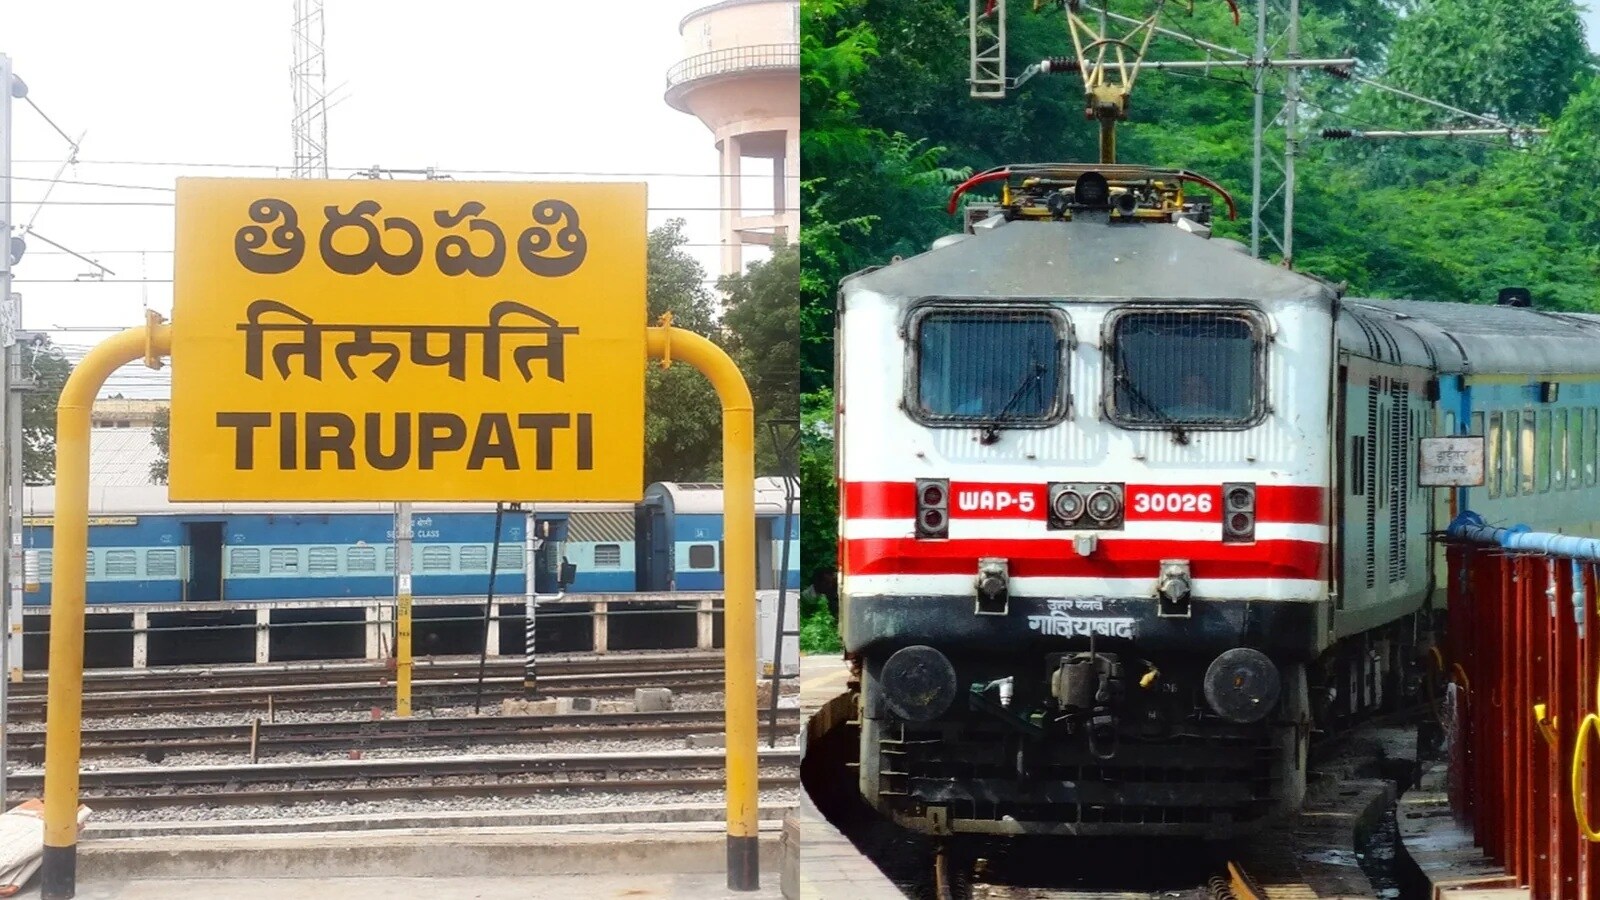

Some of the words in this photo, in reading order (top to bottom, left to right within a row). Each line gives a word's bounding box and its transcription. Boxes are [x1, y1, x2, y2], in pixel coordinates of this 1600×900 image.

[234, 198, 588, 277] తిరుపతి
[236, 299, 580, 383] तिरुपति
[216, 411, 594, 471] TIRUPATI
[958, 491, 1035, 512] WAP-5
[1134, 493, 1212, 512] 30026
[417, 530, 440, 538] CLASS
